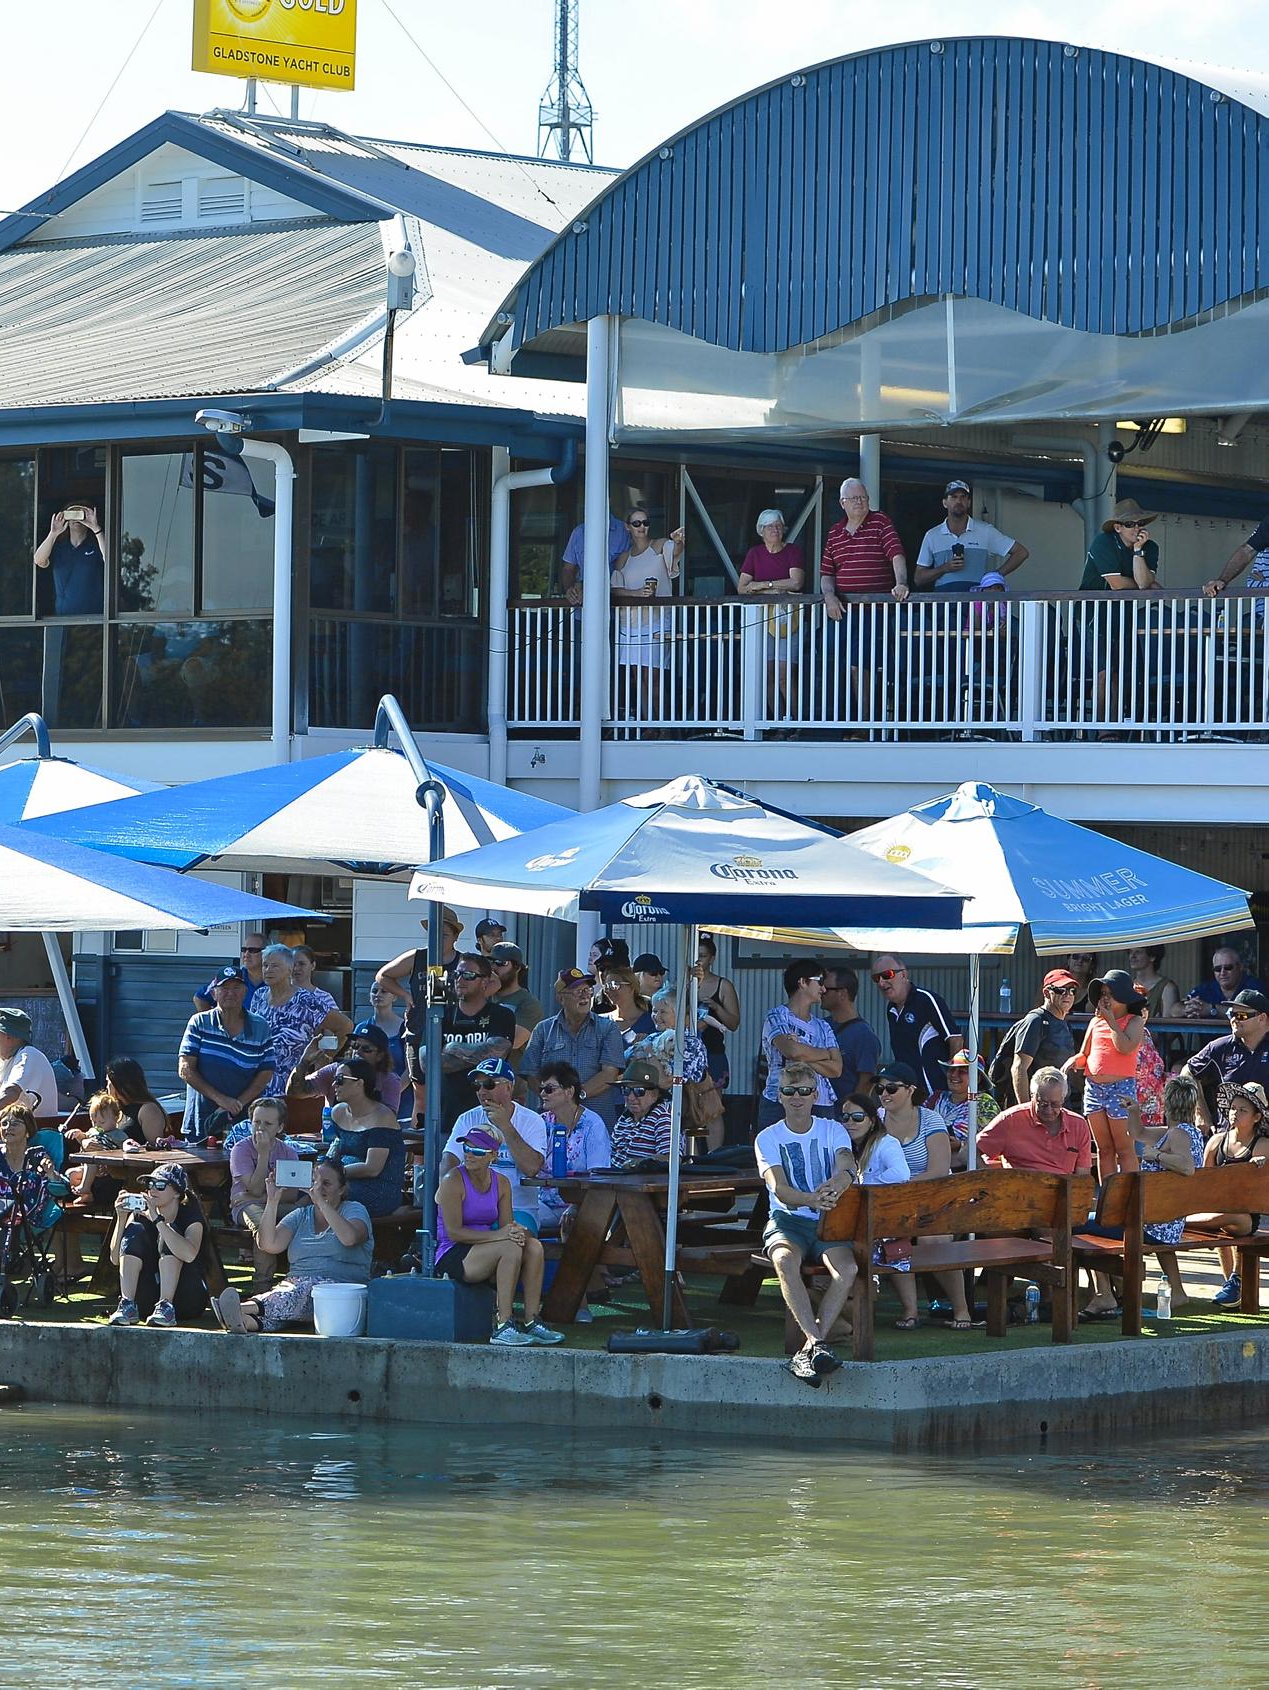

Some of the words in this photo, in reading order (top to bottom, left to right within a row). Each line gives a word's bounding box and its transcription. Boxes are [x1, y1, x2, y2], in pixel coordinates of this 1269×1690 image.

[213, 46, 280, 67] GLADSTONE
[283, 57, 319, 73] YACHT
[322, 63, 351, 77] CLUB
[710, 863, 799, 882] Corona
[1032, 867, 1148, 899] SUMMER
[621, 901, 671, 919] Corona
[1062, 902, 1106, 912] BRIGHT
[1106, 894, 1149, 910] LAGER
